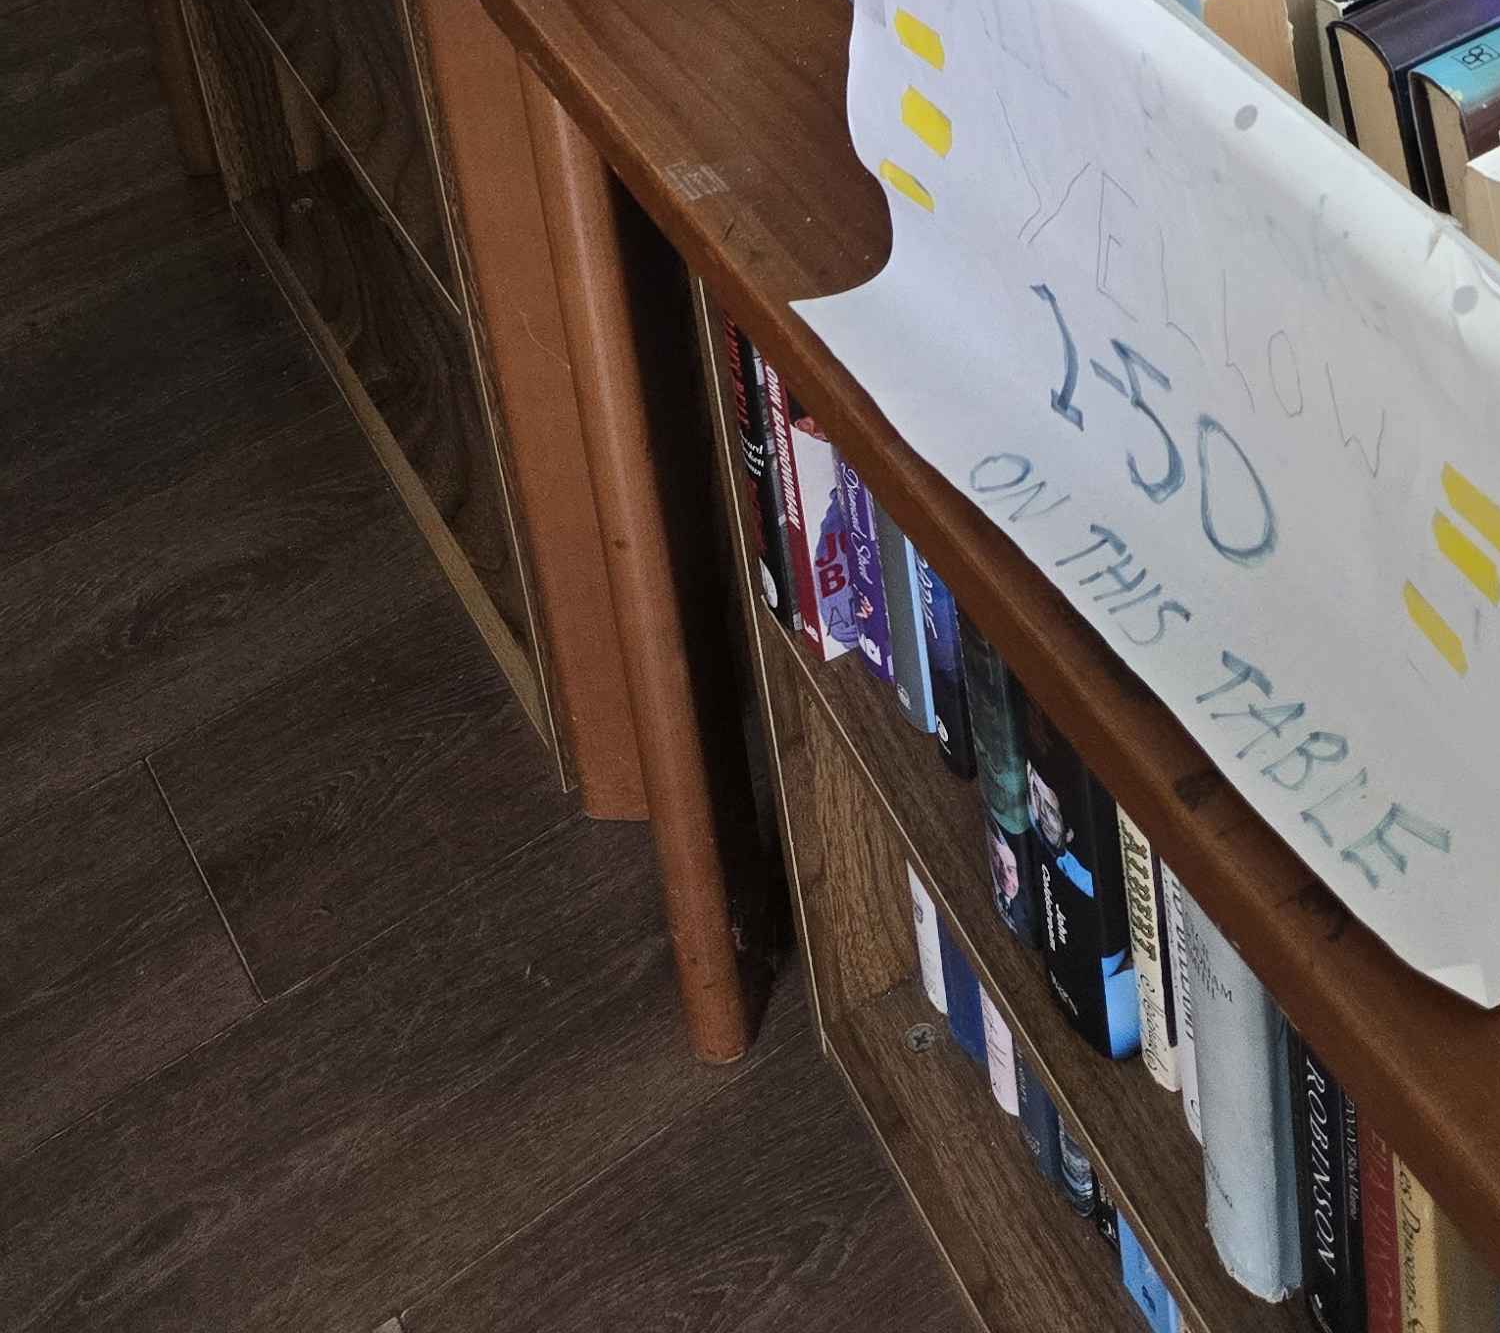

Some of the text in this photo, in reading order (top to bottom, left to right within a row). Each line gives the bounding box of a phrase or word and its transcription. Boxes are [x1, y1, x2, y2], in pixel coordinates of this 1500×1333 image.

[969, 450, 1452, 893] ON THIS TABLE
